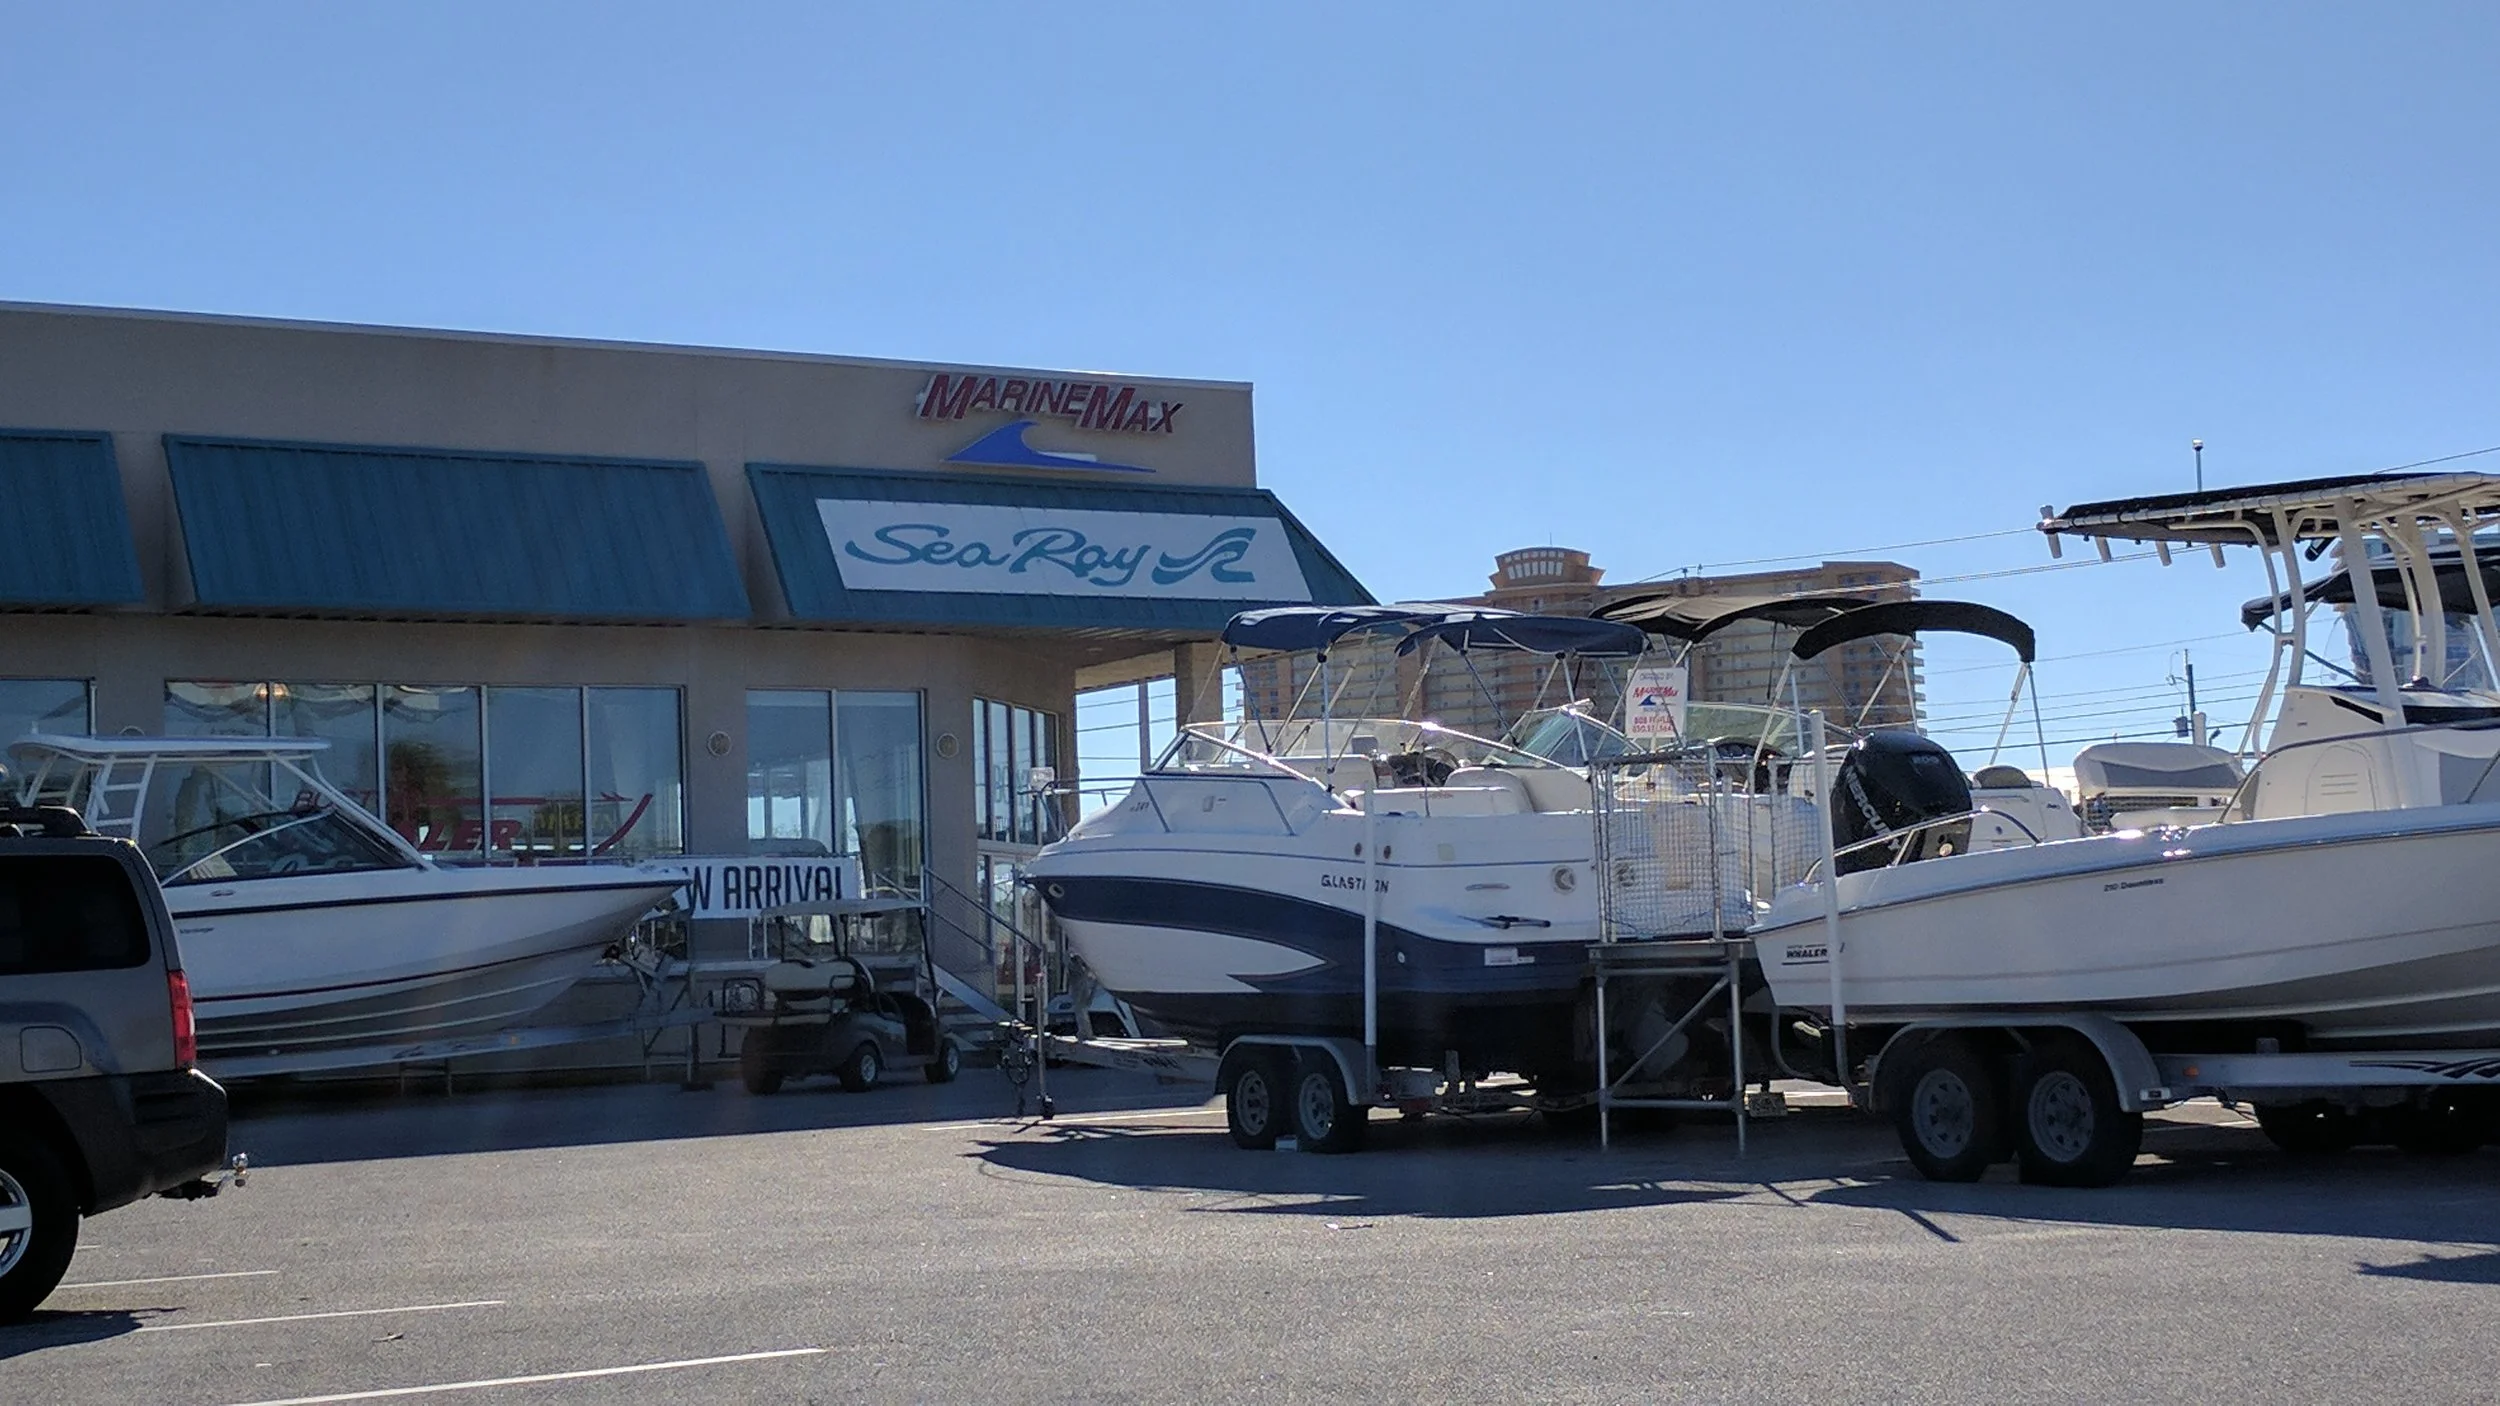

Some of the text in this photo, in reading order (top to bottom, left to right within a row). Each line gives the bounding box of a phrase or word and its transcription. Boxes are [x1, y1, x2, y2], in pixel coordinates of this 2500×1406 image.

[918, 374, 1184, 433] MARINEMAX
[844, 523, 1151, 586] Sea Ray
